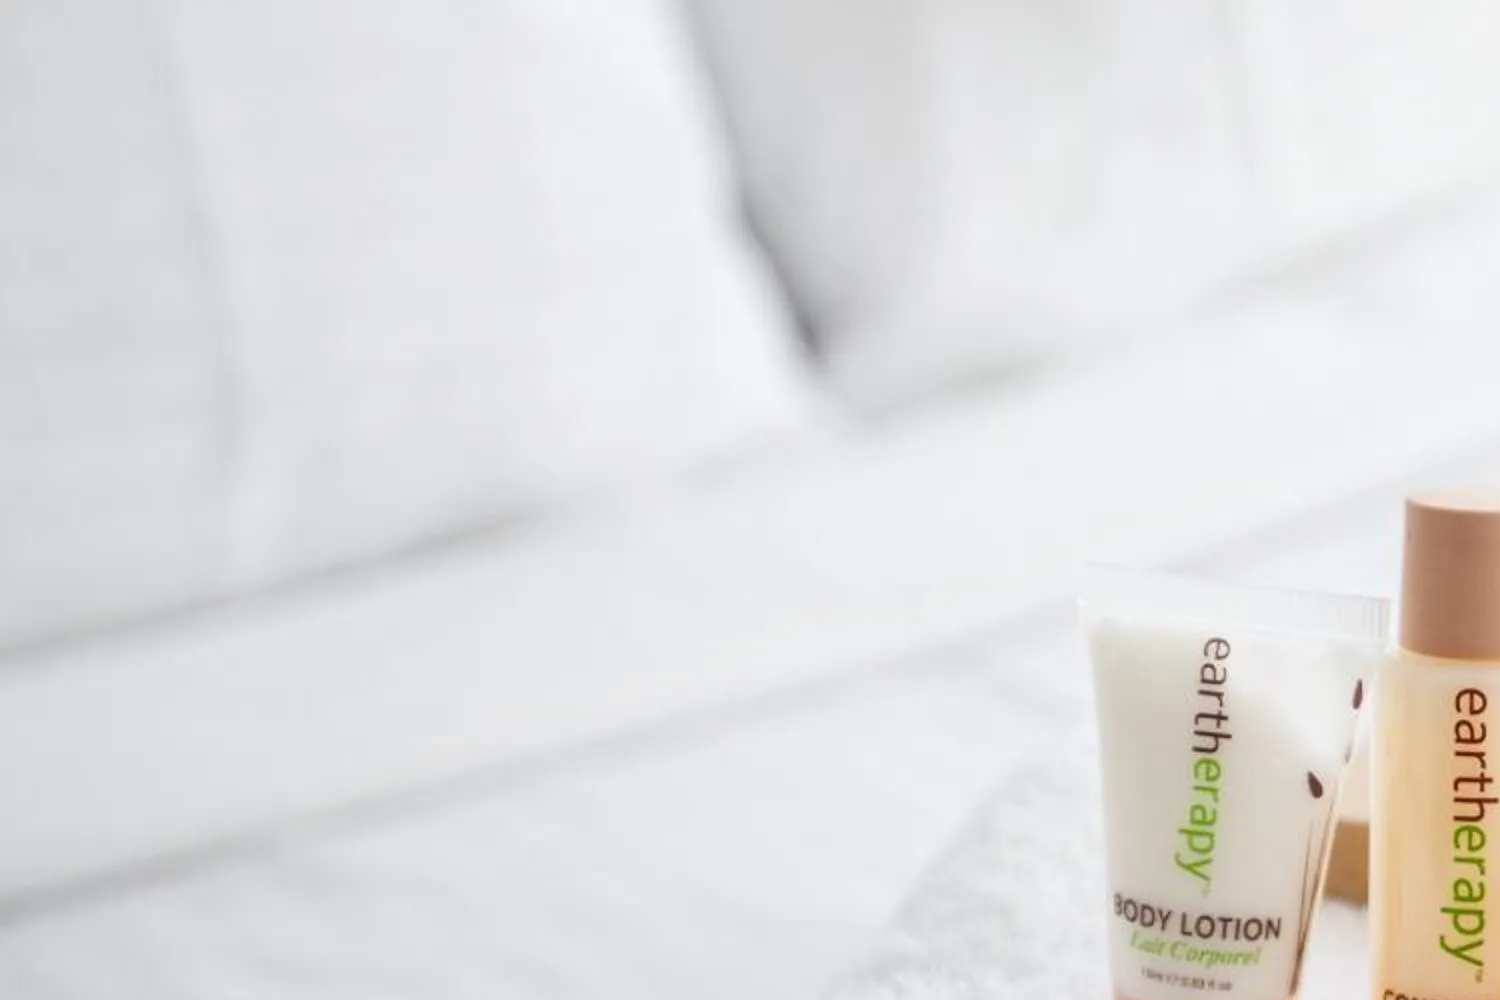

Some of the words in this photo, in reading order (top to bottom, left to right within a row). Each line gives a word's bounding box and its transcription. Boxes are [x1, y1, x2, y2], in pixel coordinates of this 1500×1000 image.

[1175, 637, 1232, 881] eartherapy
[1440, 687, 1500, 967] eartherapy
[1113, 892, 1173, 932] BODY
[1180, 912, 1282, 942] LOTION
